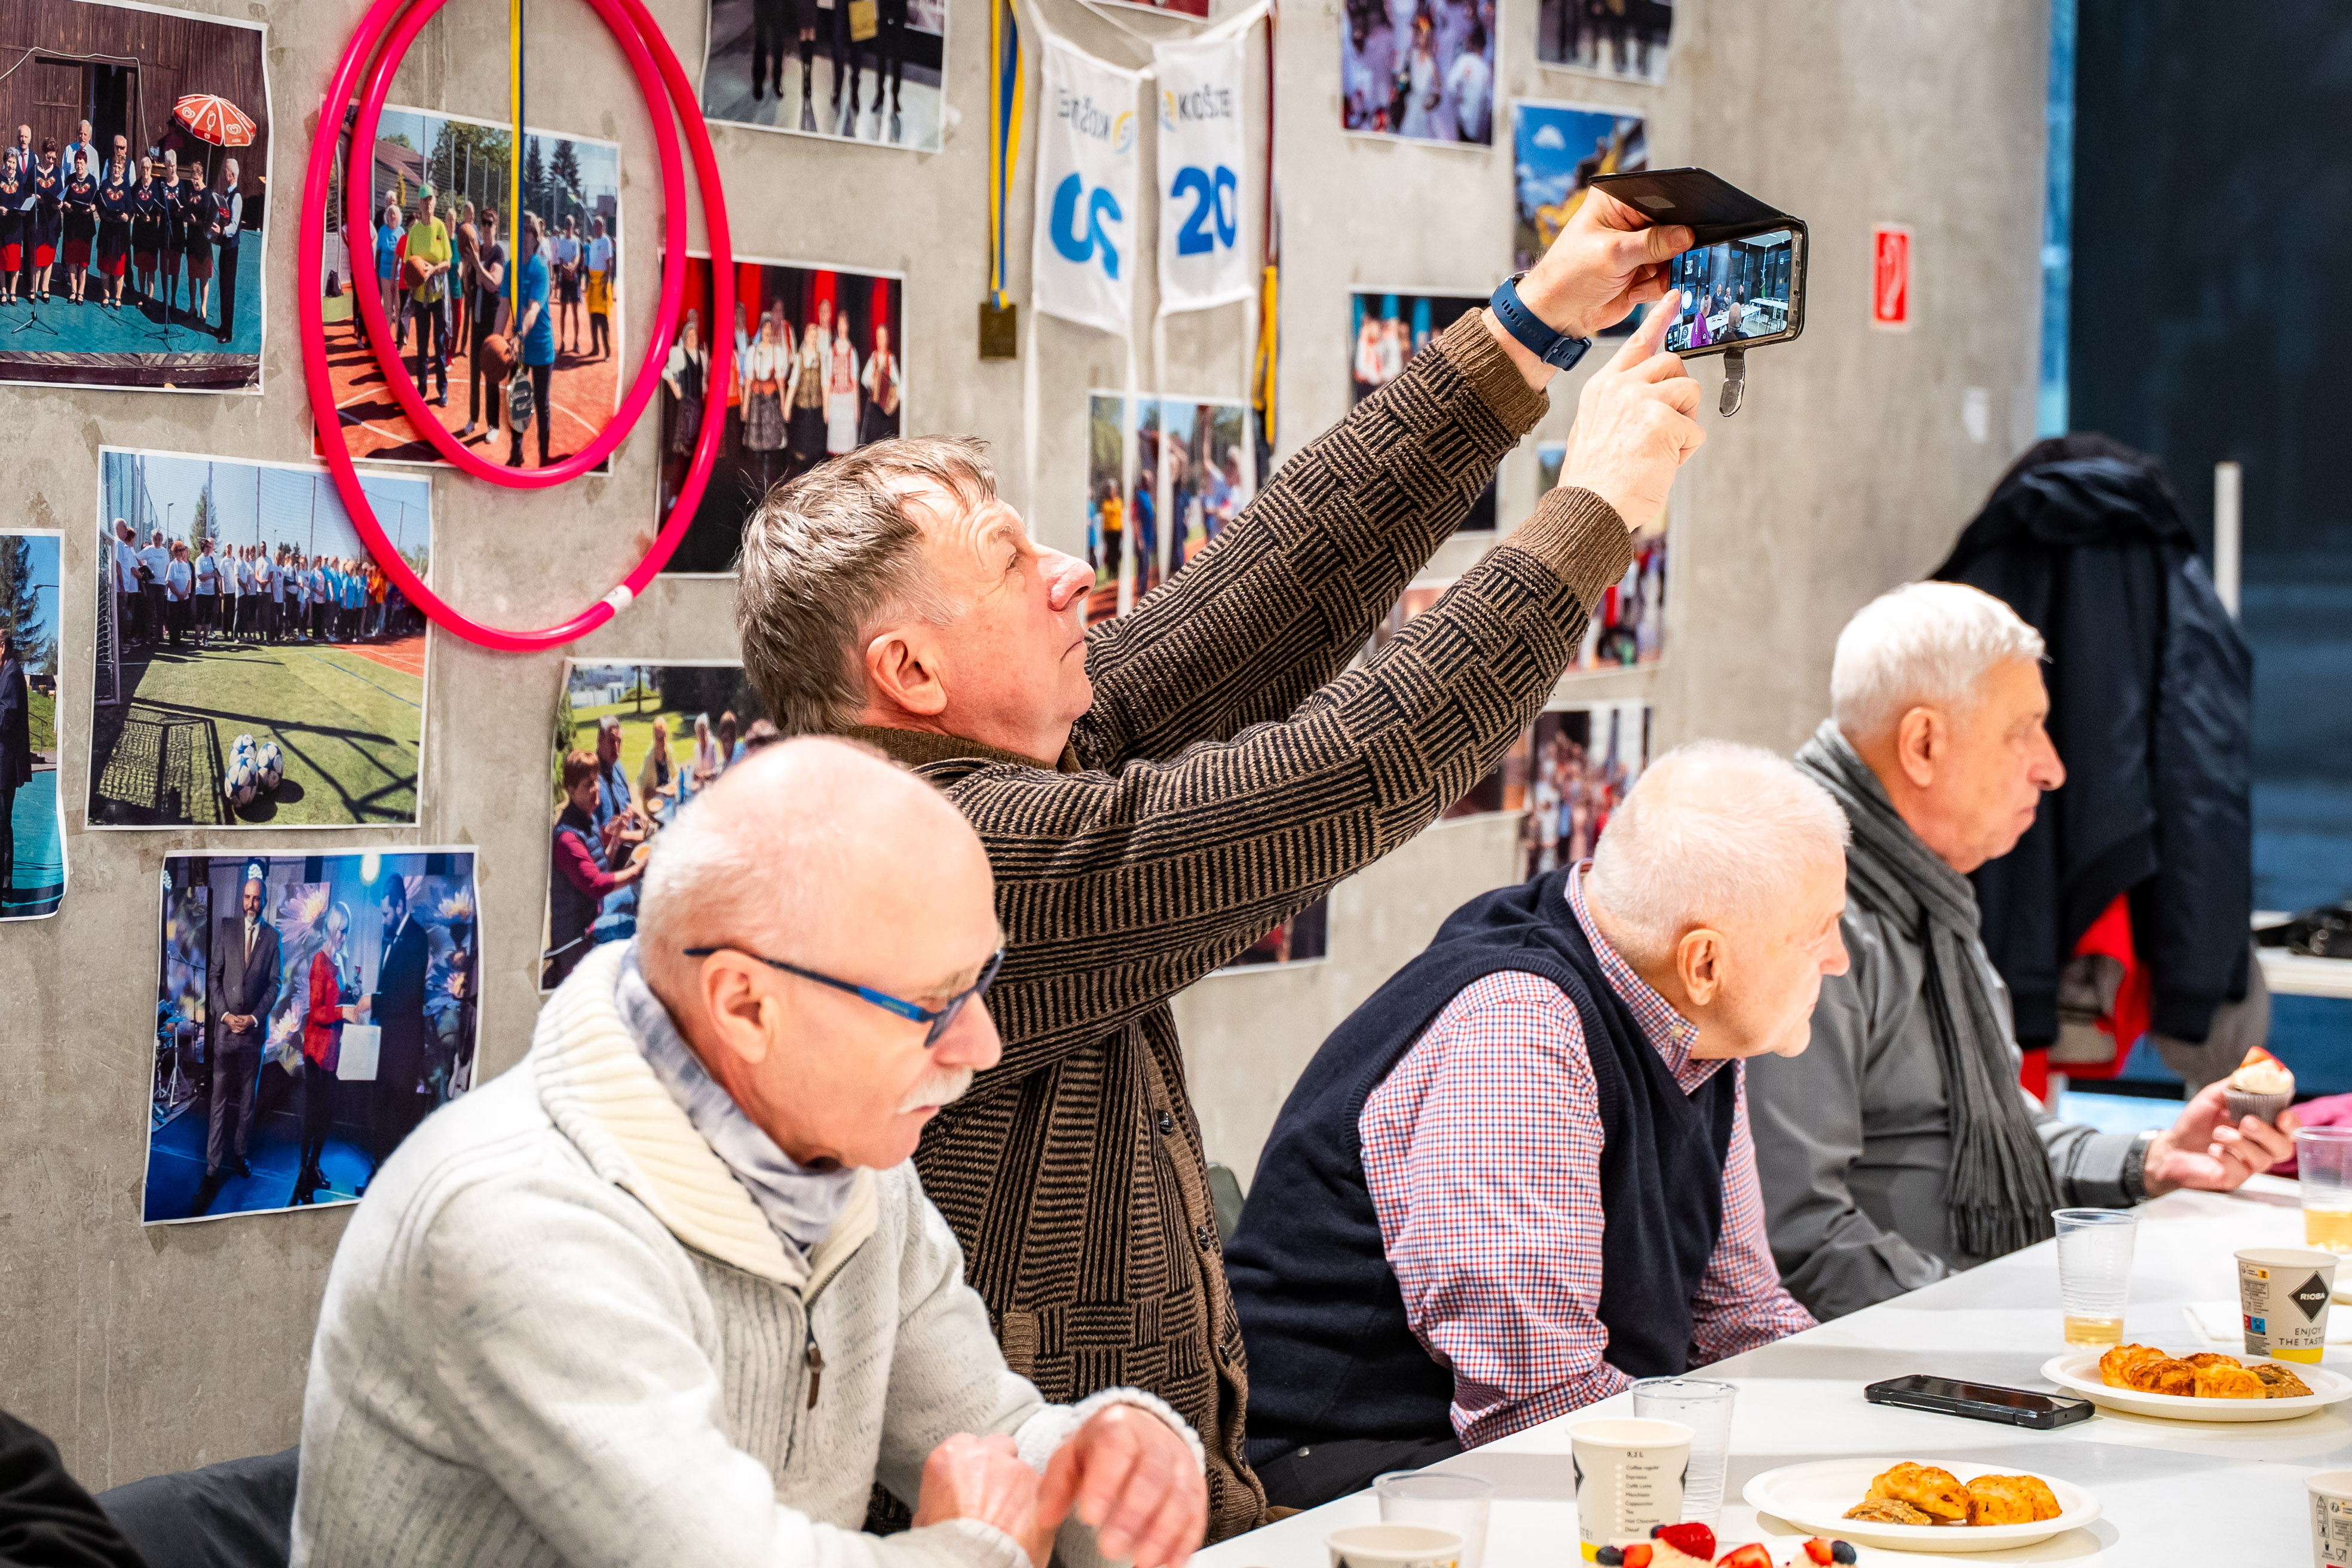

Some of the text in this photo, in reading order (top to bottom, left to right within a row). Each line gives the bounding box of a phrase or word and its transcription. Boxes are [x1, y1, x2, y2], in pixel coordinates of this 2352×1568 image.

[1171, 165, 1236, 255] 20
[2300, 1292, 2326, 1300] RIOBA
[2295, 1327, 2322, 1337] ENJOY
[2278, 1338, 2299, 1346] THE
